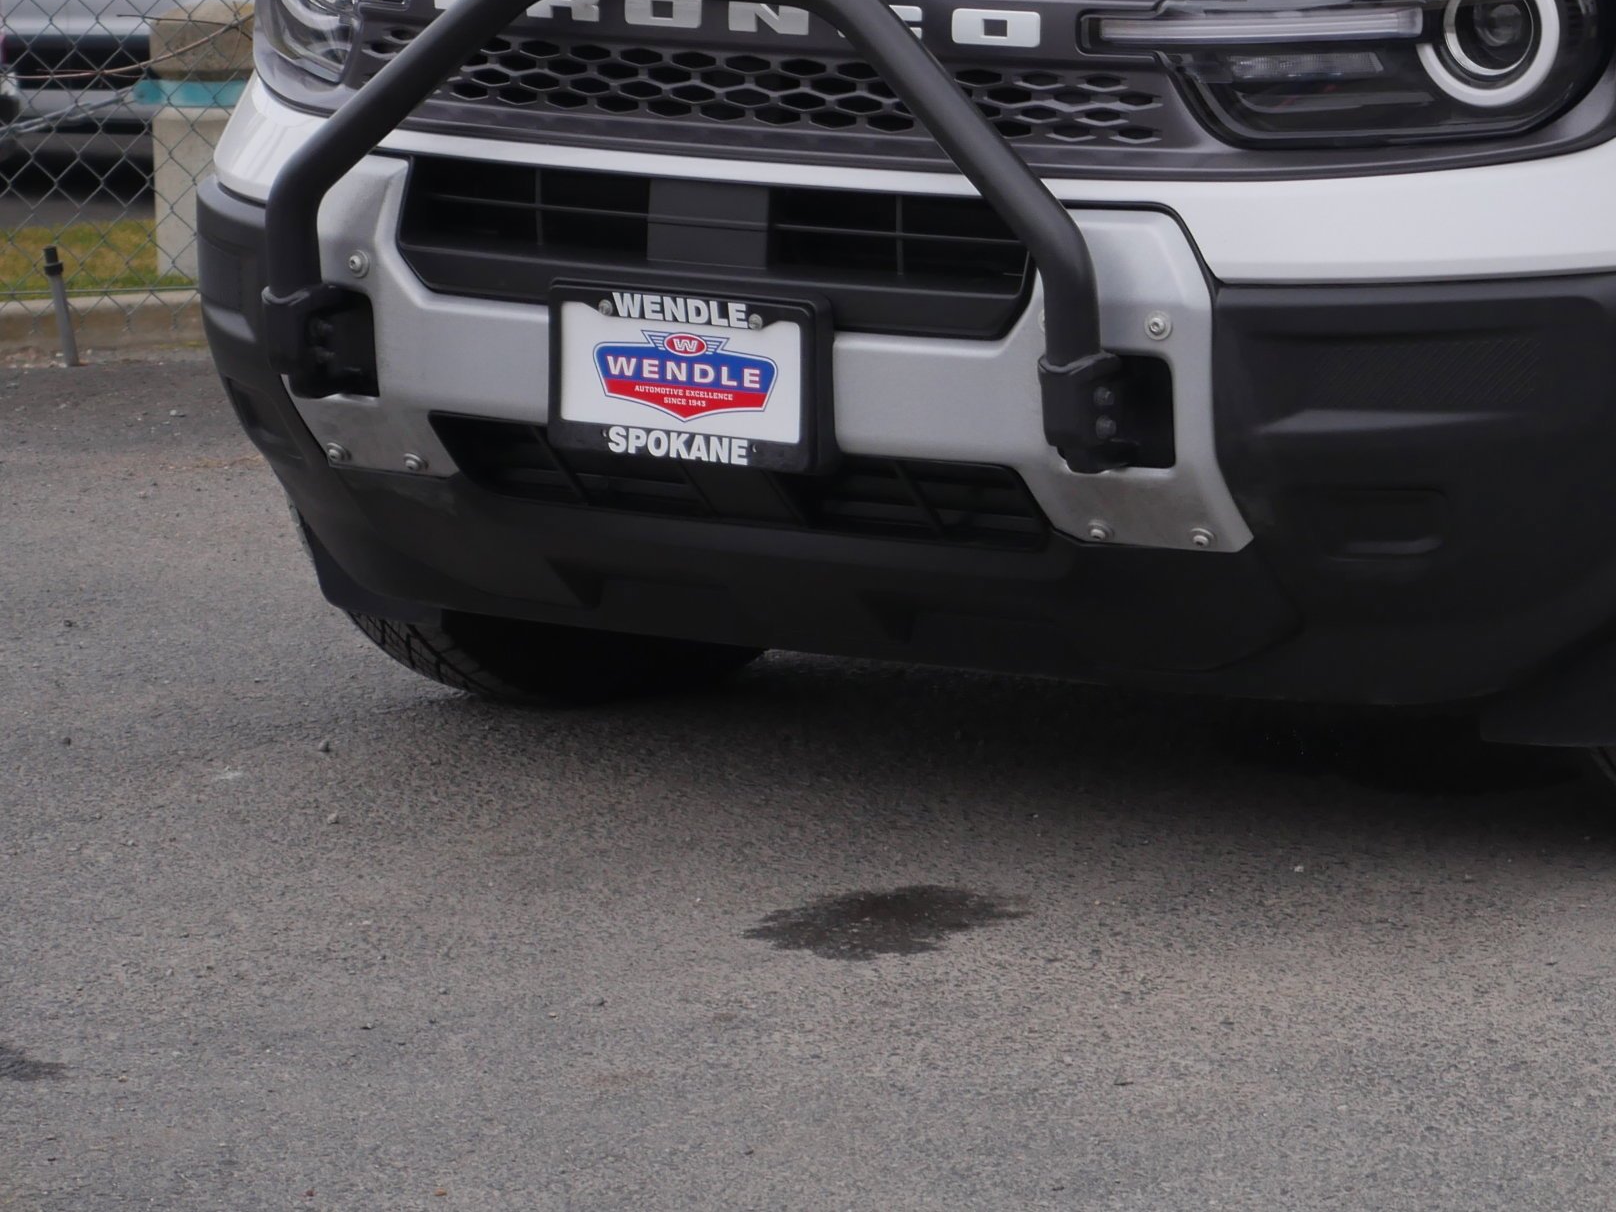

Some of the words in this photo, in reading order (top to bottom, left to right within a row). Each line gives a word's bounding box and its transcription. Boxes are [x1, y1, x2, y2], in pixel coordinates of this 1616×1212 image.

[612, 292, 750, 329] WENDLE
[673, 338, 699, 353] W
[606, 355, 761, 389] WENDLE
[634, 385, 684, 396] AUTOMOTIVE
[685, 389, 733, 400] EXCELLENCE
[663, 397, 687, 406] SINCE
[688, 398, 706, 407] 1943
[608, 425, 749, 466] SPOKANE
